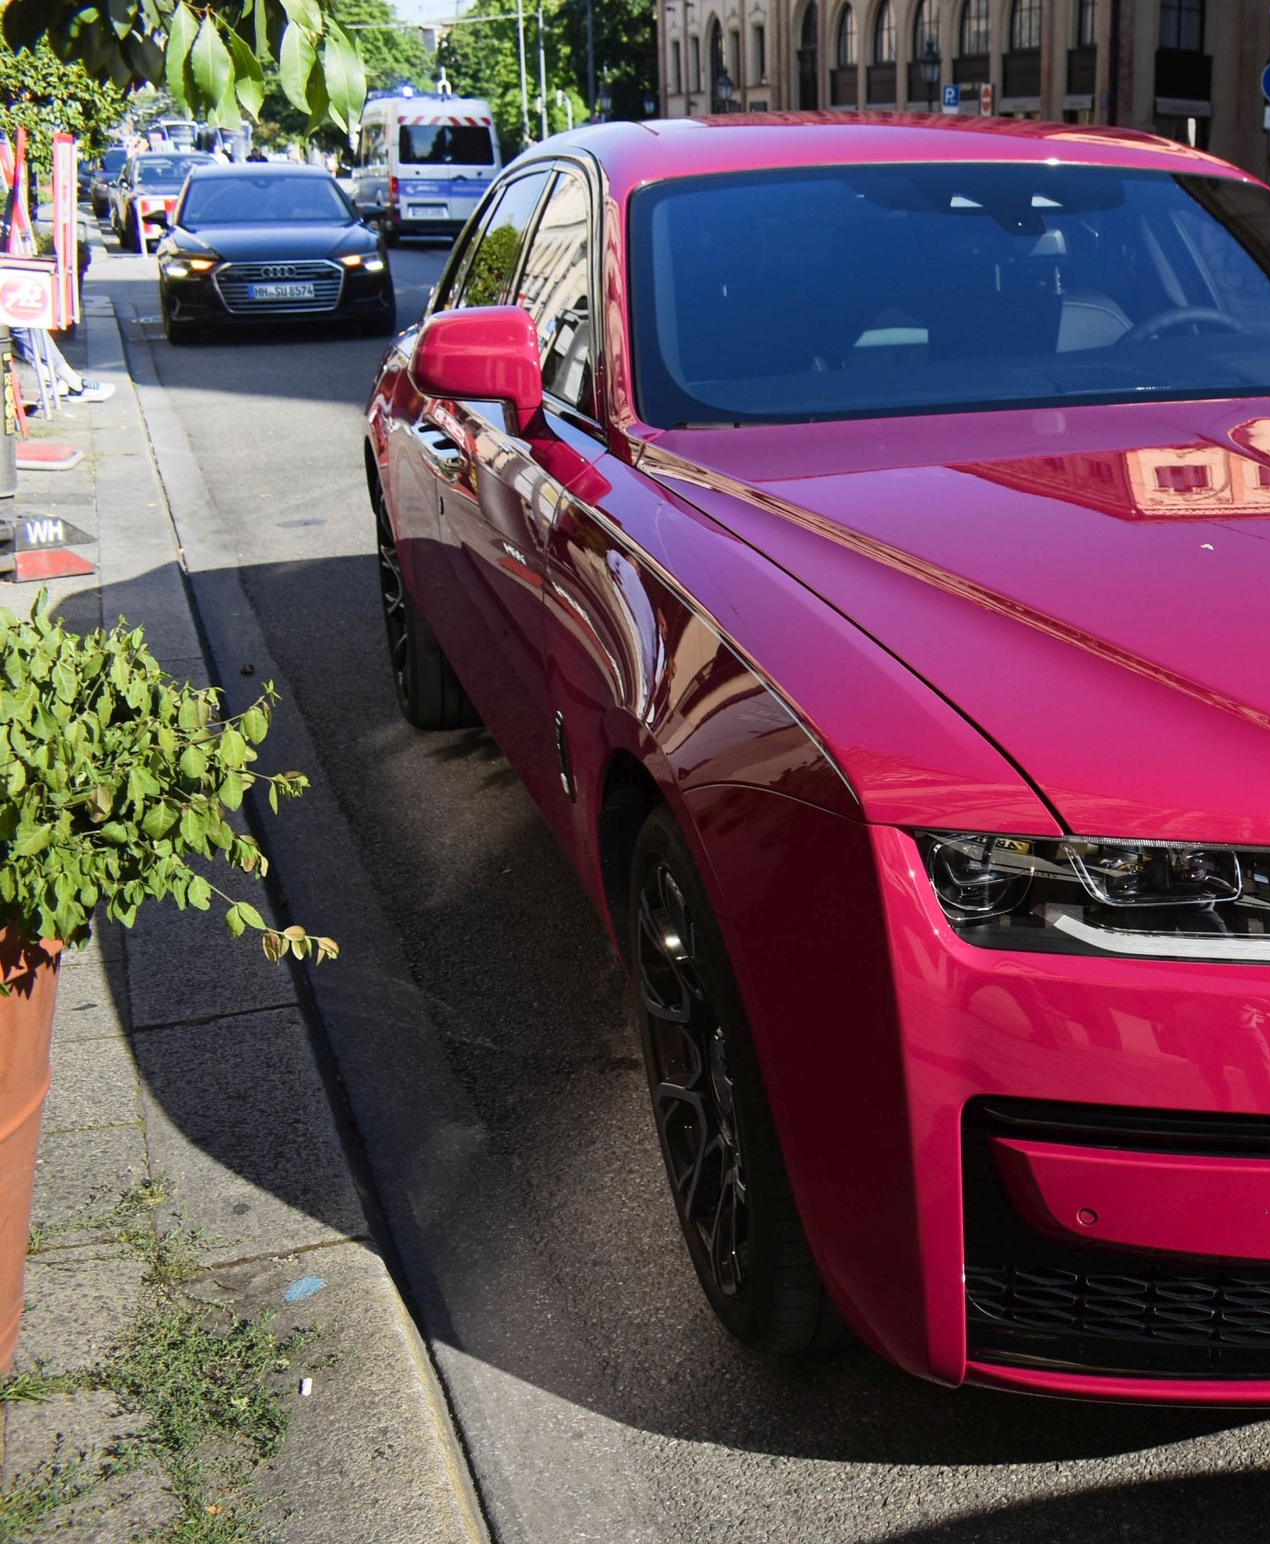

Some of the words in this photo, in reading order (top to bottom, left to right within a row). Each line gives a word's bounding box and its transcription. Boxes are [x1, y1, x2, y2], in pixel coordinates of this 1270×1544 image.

[255, 287, 268, 297] HH
[274, 286, 288, 297] SU
[289, 286, 313, 296] 8574
[27, 519, 63, 544] WH
